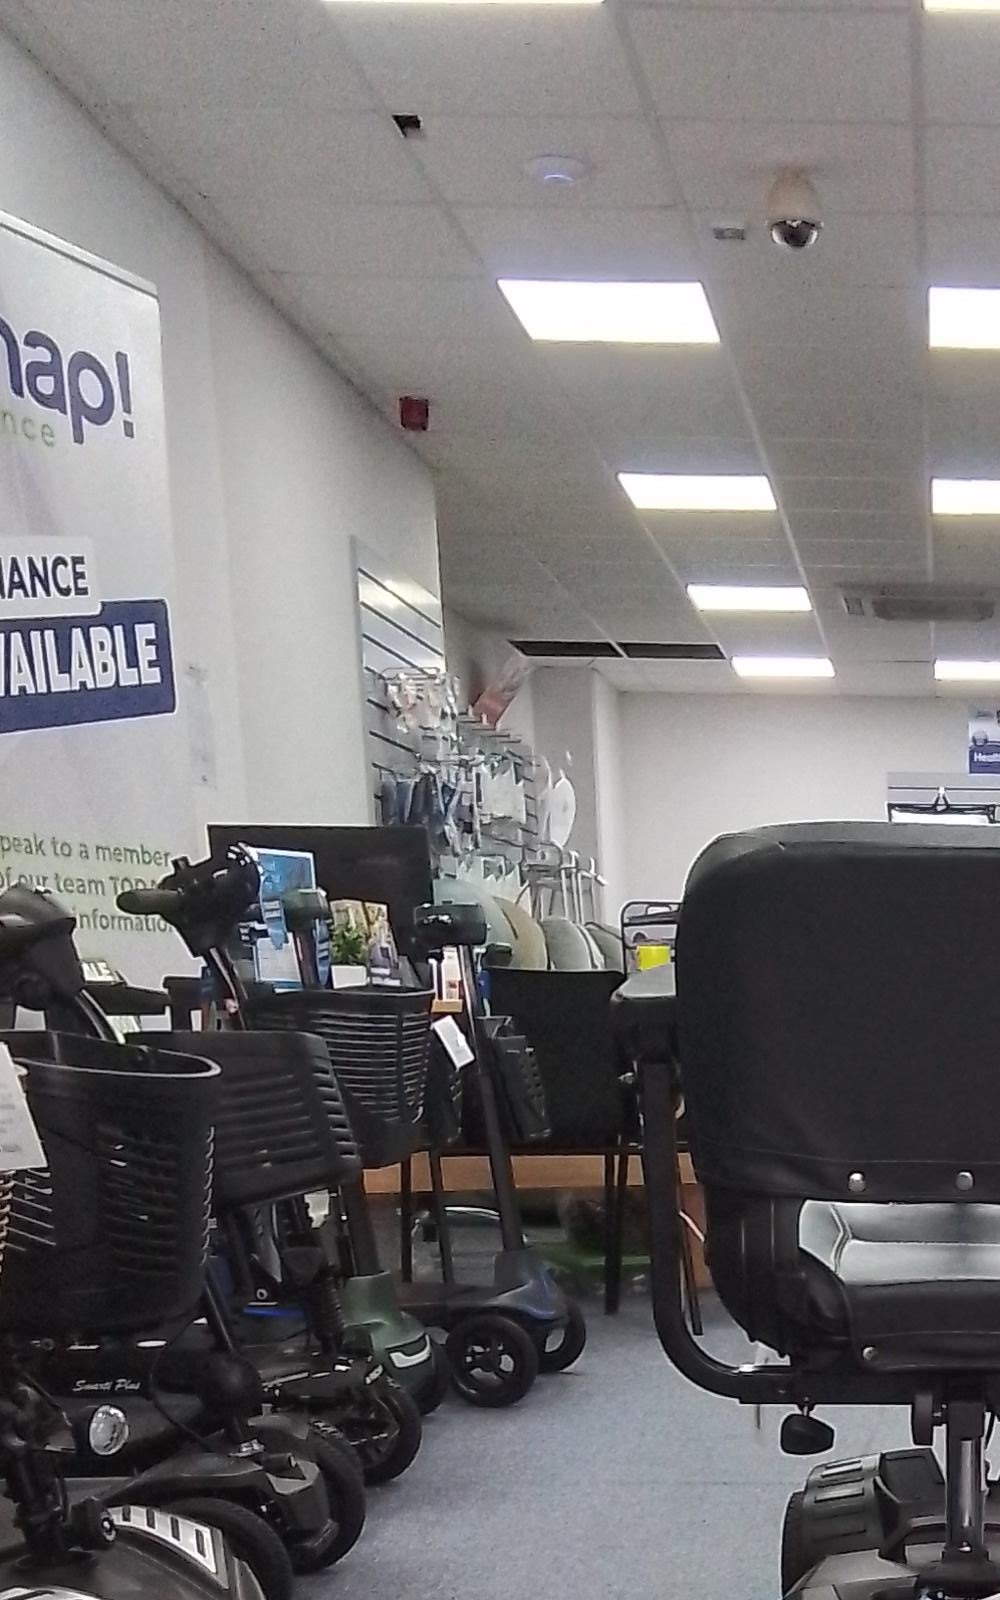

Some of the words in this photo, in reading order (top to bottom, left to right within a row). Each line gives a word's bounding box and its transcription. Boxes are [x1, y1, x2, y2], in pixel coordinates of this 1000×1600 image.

[0, 555, 89, 600] ANCE
[0, 622, 162, 698] AILABLE
[51, 836, 72, 858] to
[79, 842, 89, 861] a
[95, 843, 171, 868] member
[54, 872, 105, 896] team
[71, 905, 174, 933] nformatio
